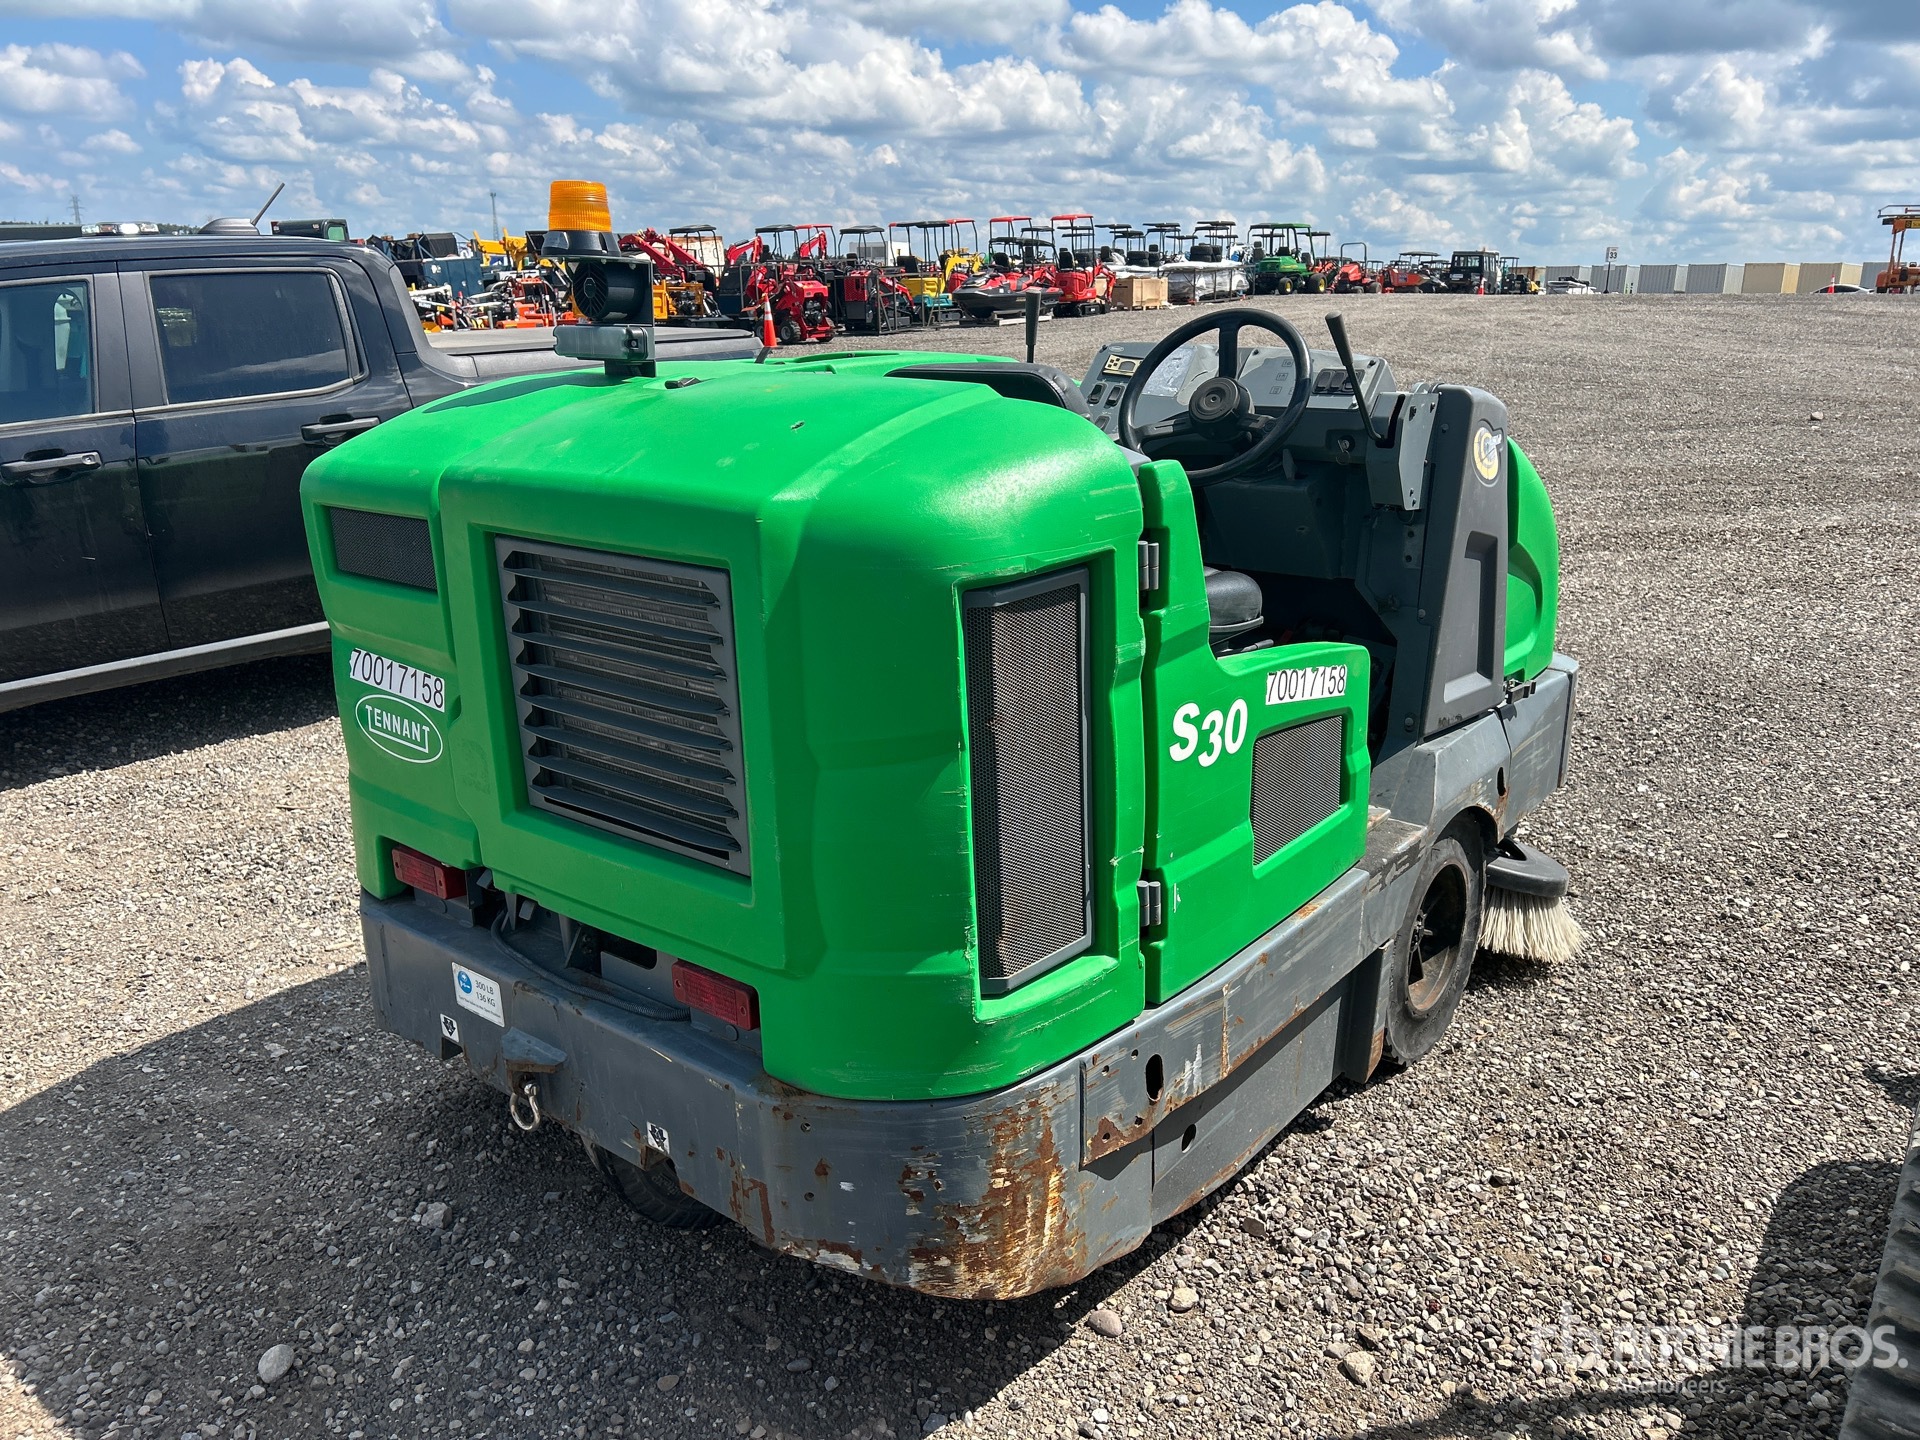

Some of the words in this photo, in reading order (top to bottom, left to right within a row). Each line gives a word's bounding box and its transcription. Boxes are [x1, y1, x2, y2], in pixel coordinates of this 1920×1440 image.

[1609, 251, 1618, 259] 33
[351, 649, 445, 709] 70017158
[1267, 666, 1346, 703] 70017158
[365, 704, 430, 754] TENNANT
[1169, 698, 1248, 768] S30
[474, 979, 486, 992] 300
[486, 985, 494, 995] LB
[475, 991, 487, 1003] 136
[486, 996, 496, 1008] KG
